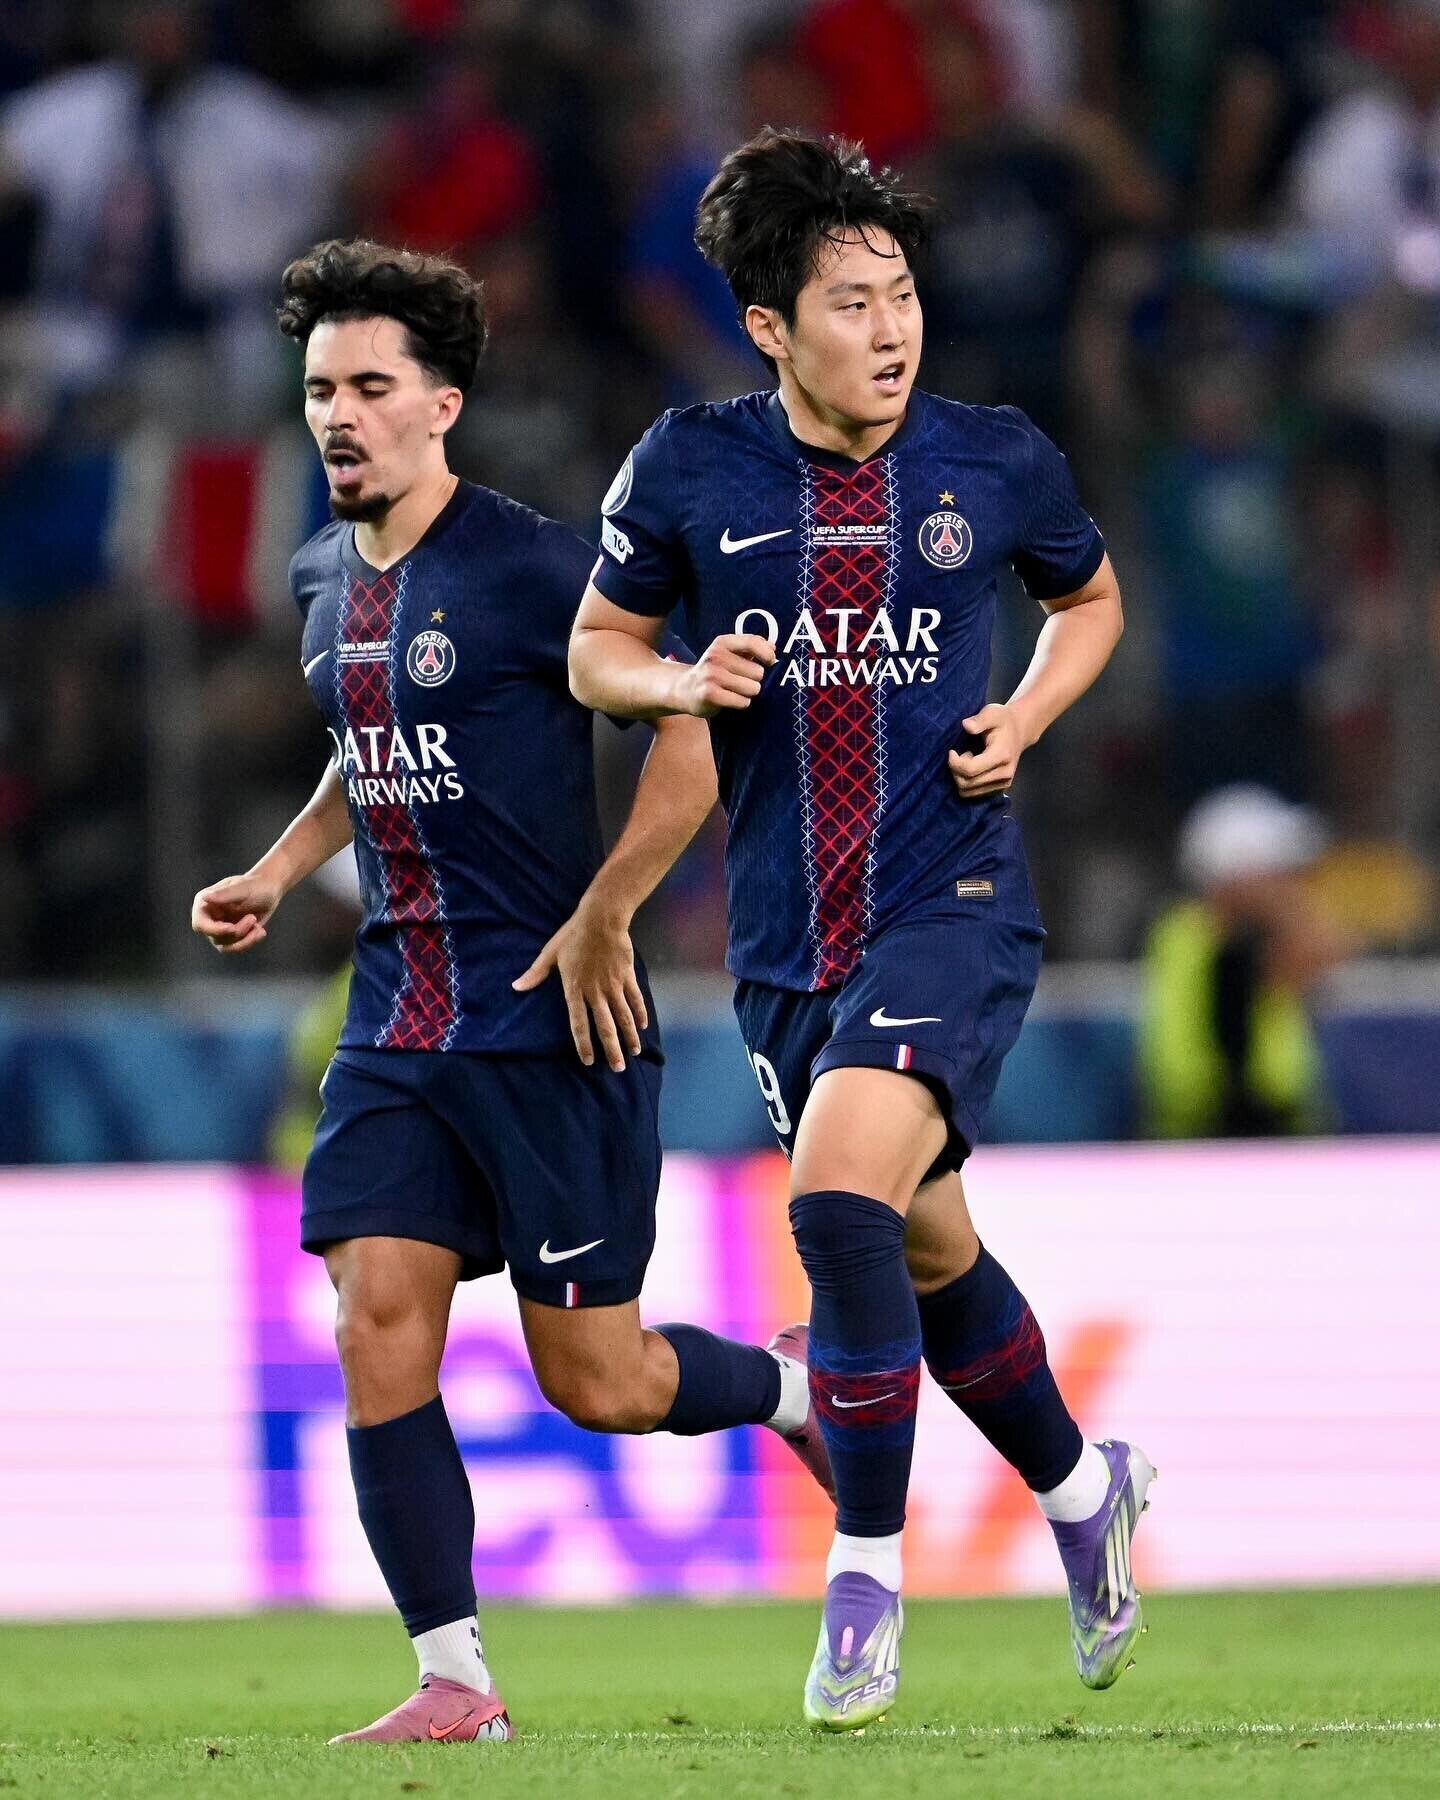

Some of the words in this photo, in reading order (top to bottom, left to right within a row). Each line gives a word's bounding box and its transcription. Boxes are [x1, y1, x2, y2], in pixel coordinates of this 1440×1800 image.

[812, 526, 836, 535] UEFA
[837, 525, 866, 534] SUPER
[866, 525, 888, 534] CUP
[928, 514, 964, 529] PARIS
[340, 642, 356, 653] UEFA
[356, 641, 376, 651] SUPER
[375, 640, 389, 650] CUP
[416, 633, 448, 649] PARIS
[779, 656, 939, 687] AIRWAYS
[348, 772, 464, 806] AIRWAYS
[745, 1044, 791, 1135] 9
[841, 1672, 896, 1714] F50
